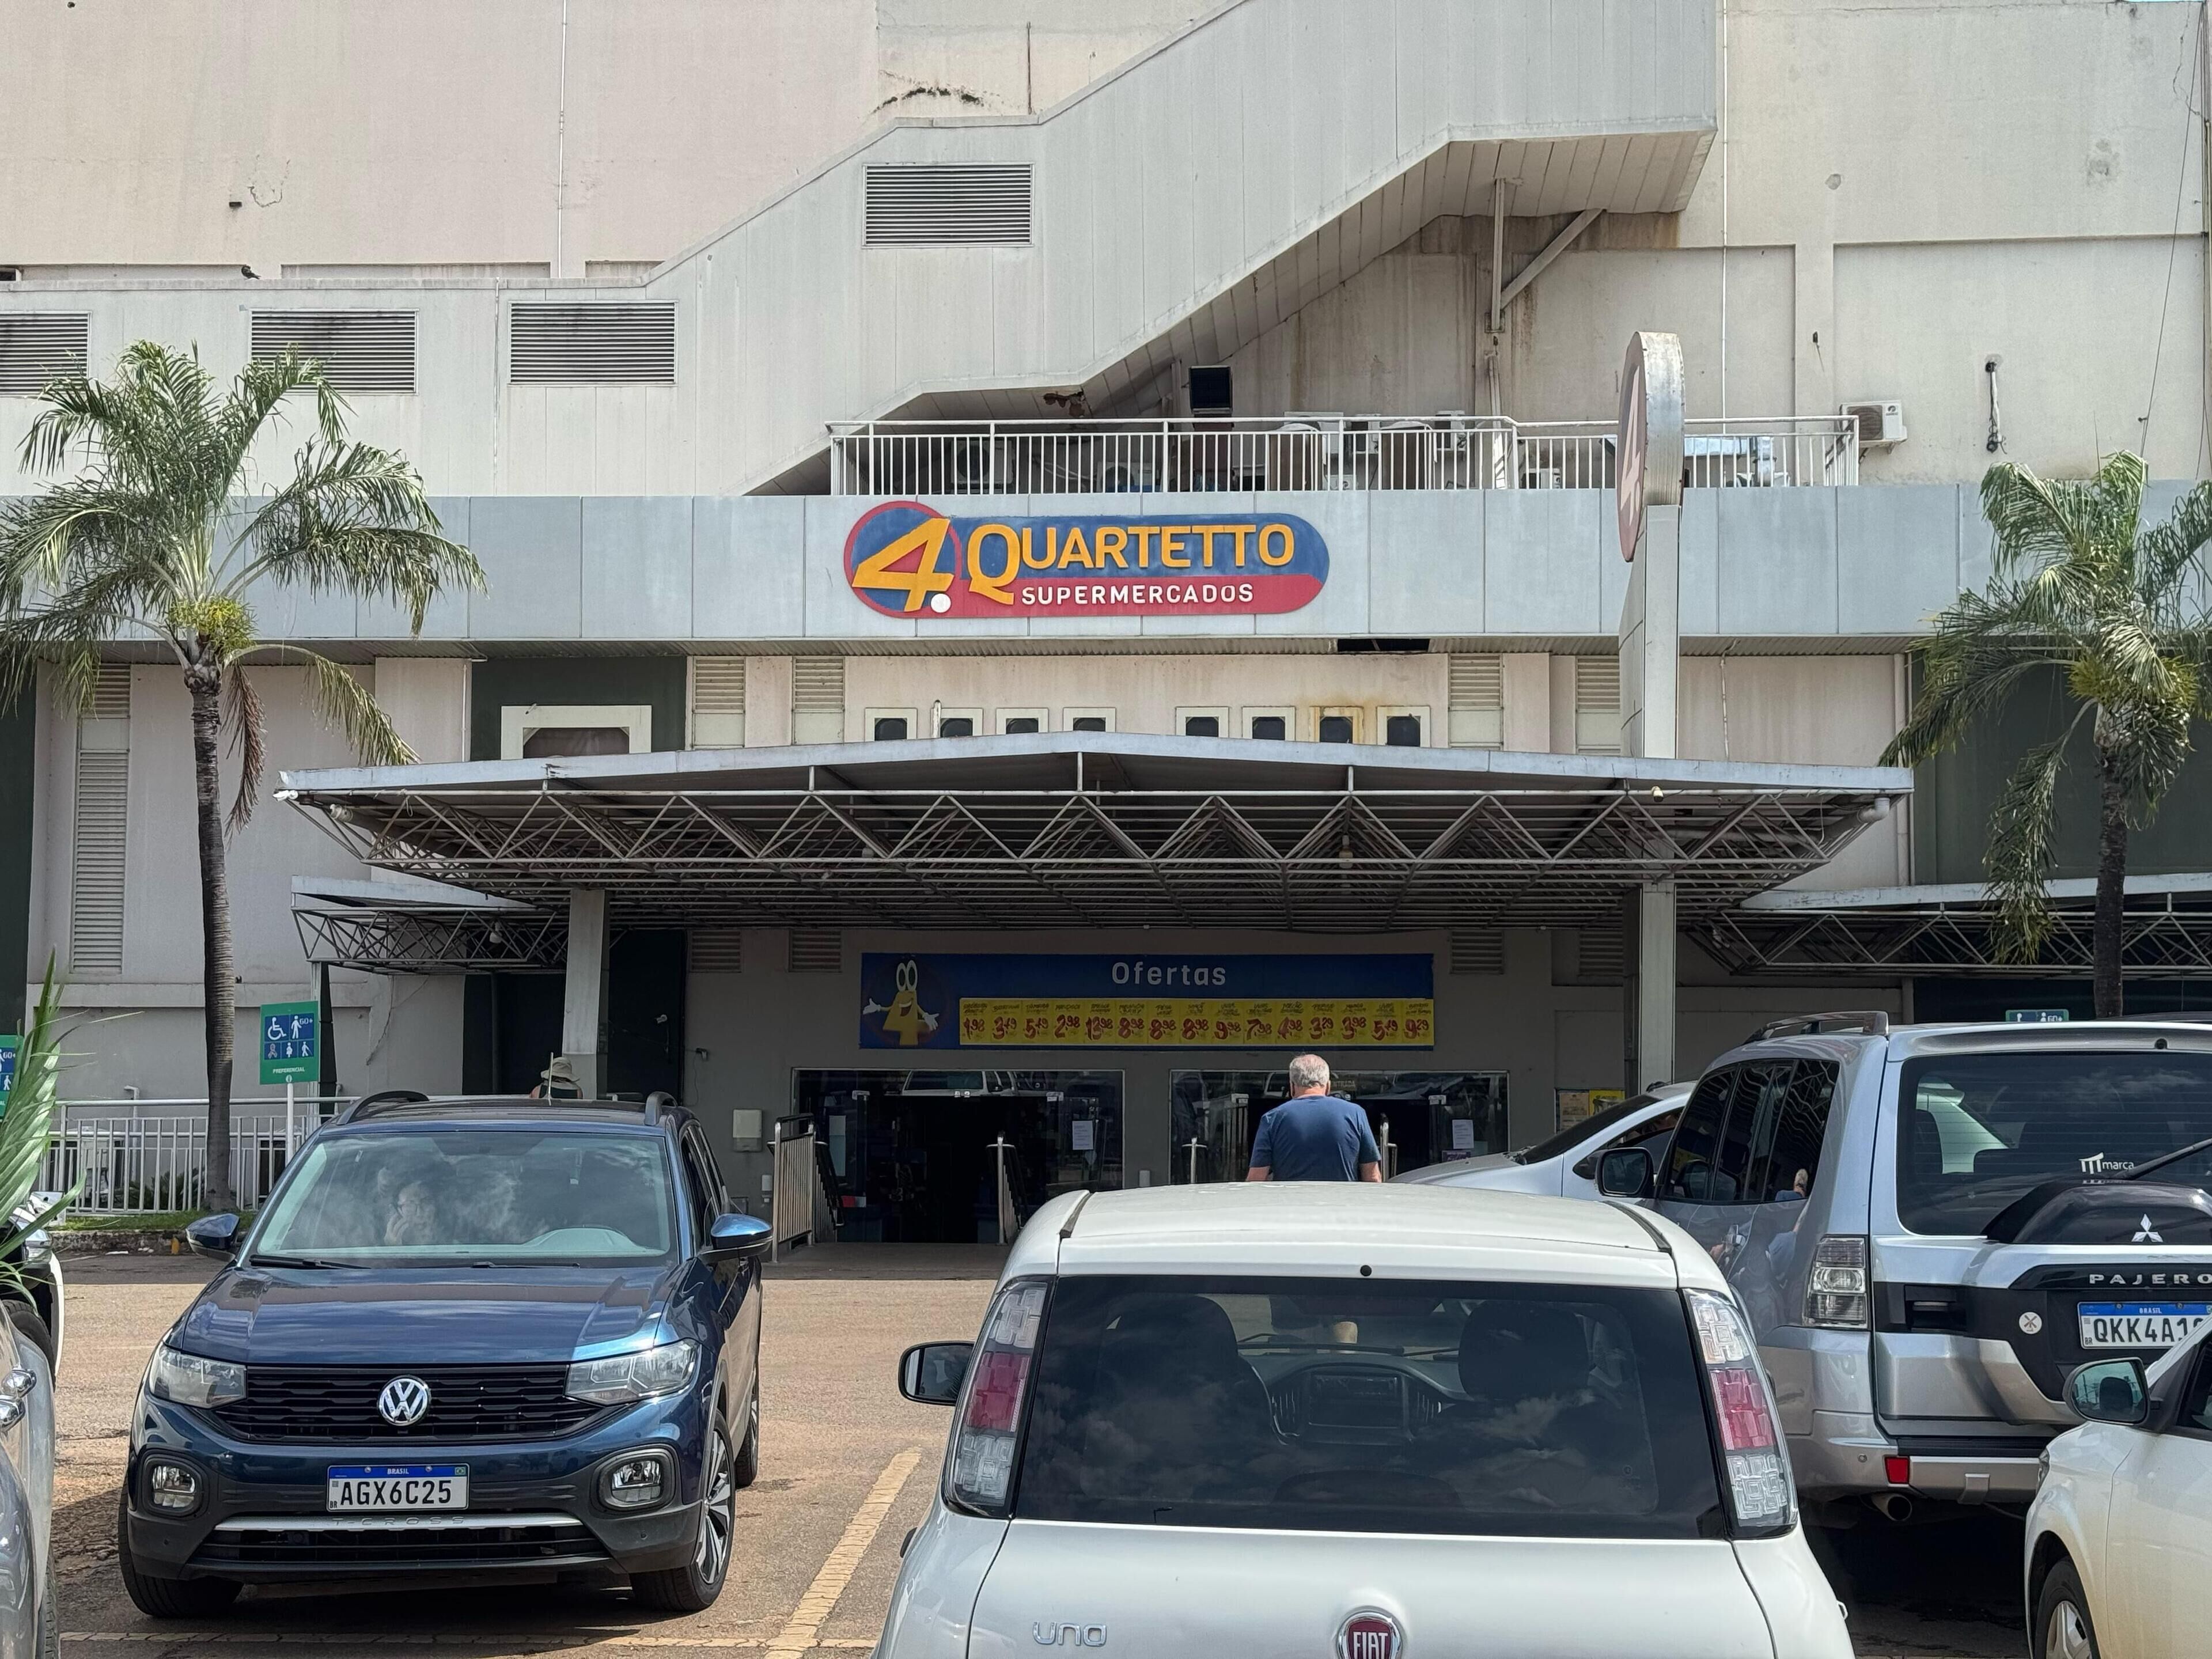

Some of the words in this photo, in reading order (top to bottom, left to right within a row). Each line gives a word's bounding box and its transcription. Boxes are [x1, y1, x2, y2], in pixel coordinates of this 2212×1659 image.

[967, 523, 1294, 605] QUARTETTO
[1021, 583, 1253, 605] SUPERMERCADOS
[1112, 961, 1226, 986] Ofertas
[2089, 1273, 2212, 1285] PAJERO
[340, 1480, 452, 1506] AGX6C25
[329, 1501, 338, 1509] BR
[332, 1516, 464, 1526] T-CROSS
[1353, 1631, 1388, 1659] FIAT
